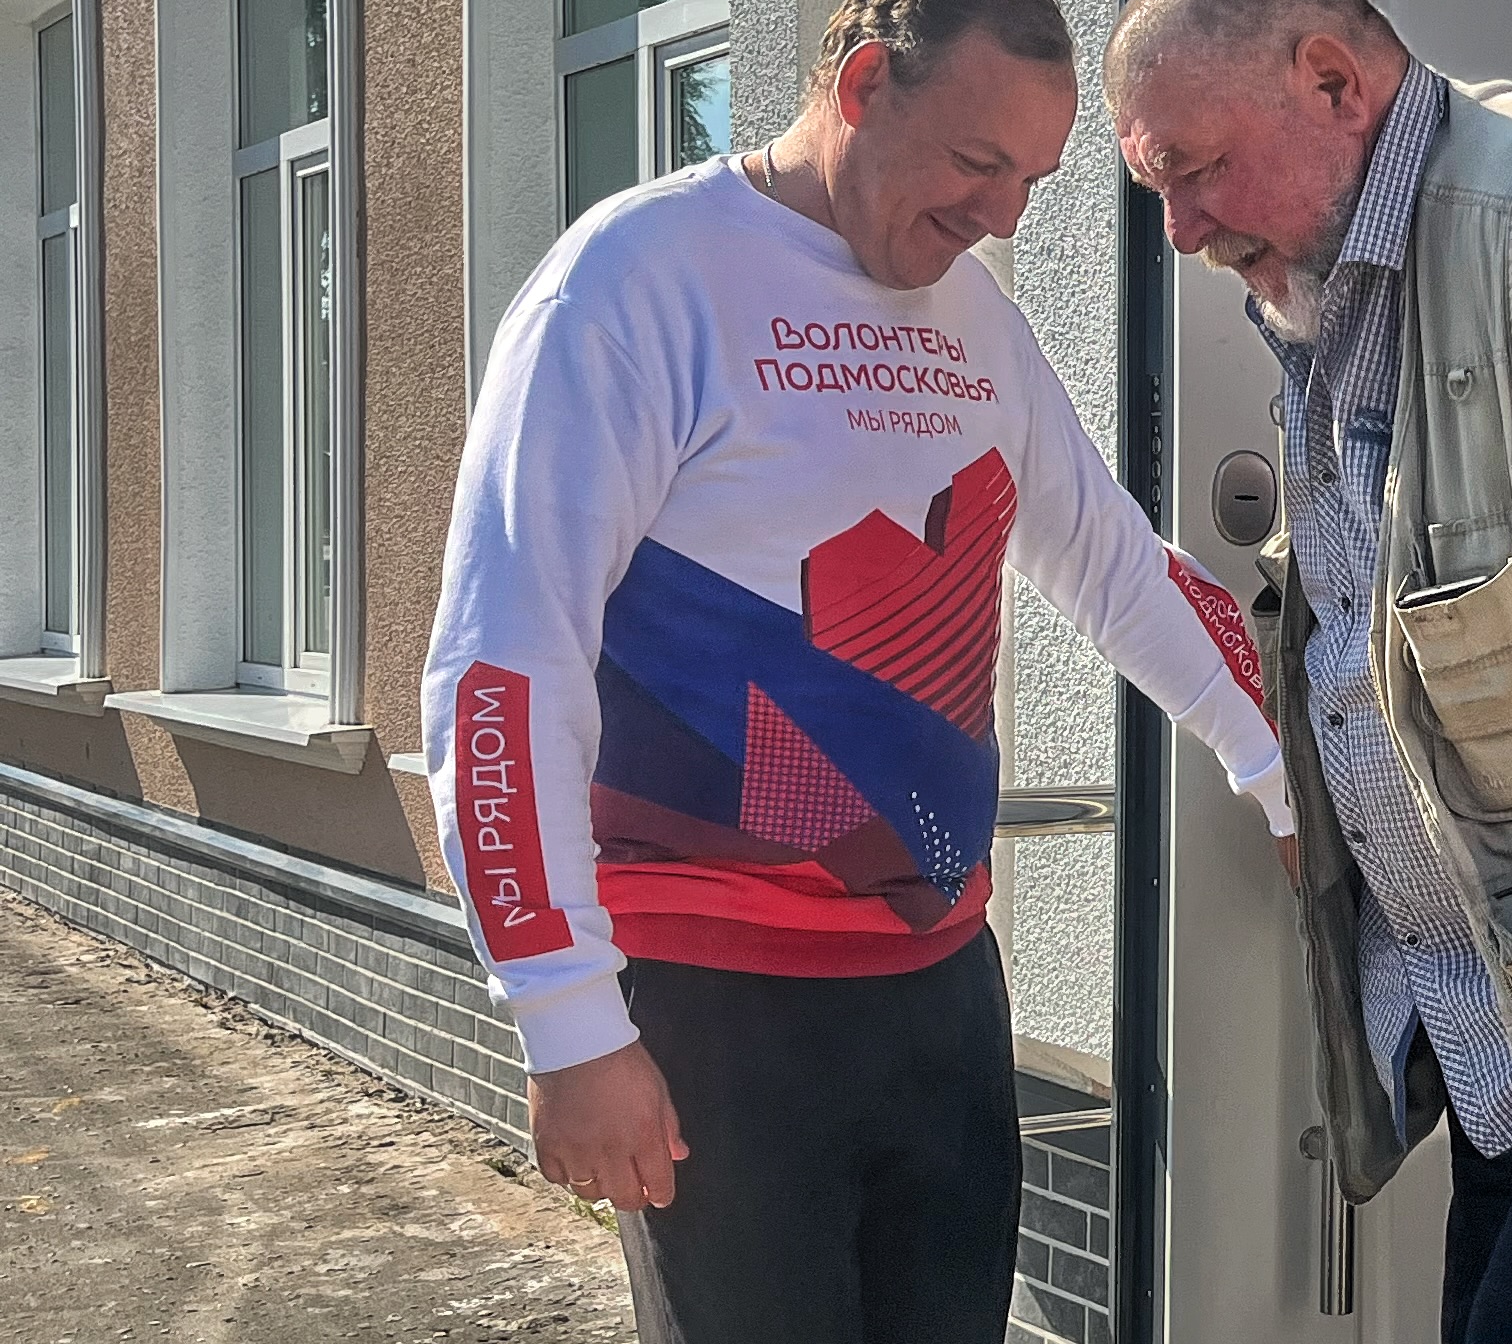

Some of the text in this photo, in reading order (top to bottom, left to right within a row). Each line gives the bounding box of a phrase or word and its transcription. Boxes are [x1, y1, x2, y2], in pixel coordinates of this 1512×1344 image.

[770, 316, 968, 364] ВОЛОНТЕРЫ
[754, 358, 1000, 404] ПОДМОСКОВЬЯ
[846, 409, 963, 438] МЫ РЯДОМ
[470, 686, 518, 853] РЯДОМ
